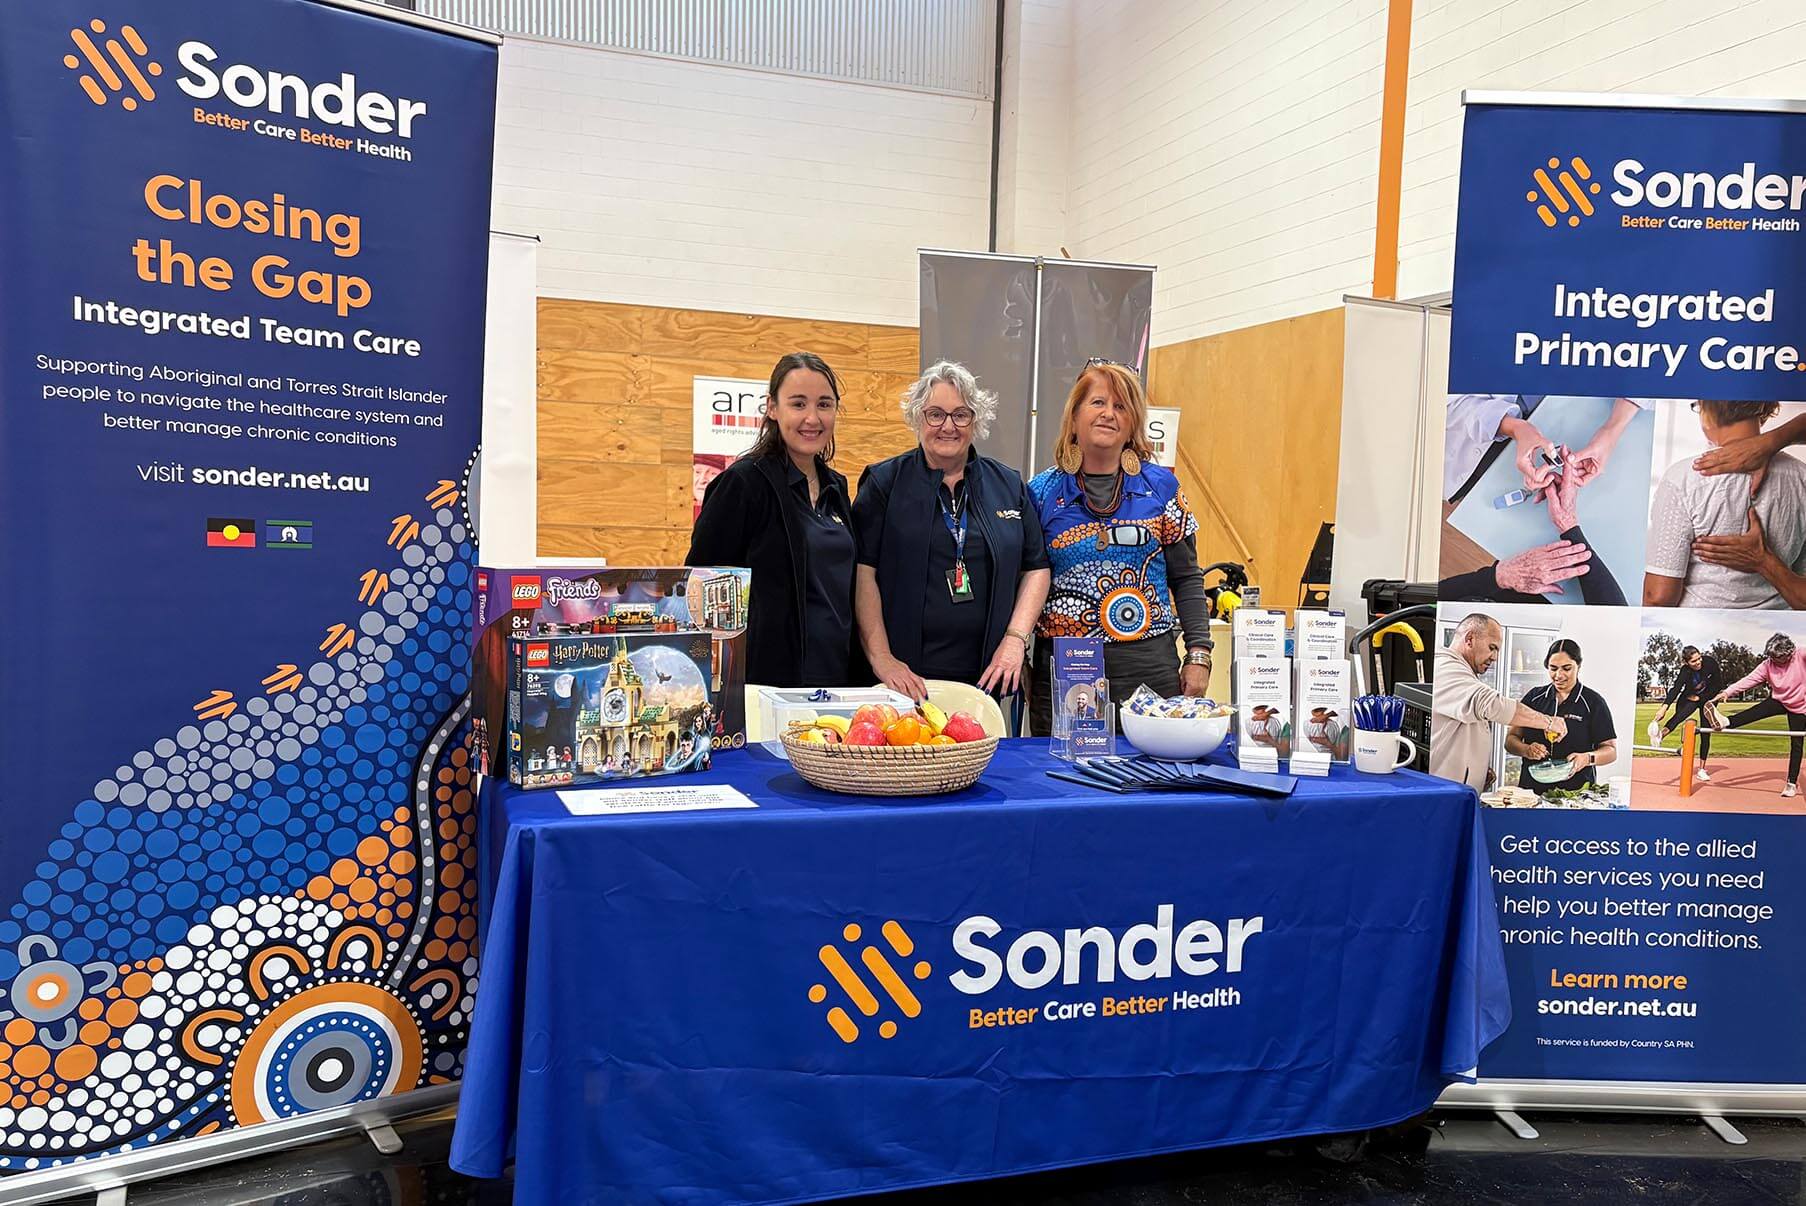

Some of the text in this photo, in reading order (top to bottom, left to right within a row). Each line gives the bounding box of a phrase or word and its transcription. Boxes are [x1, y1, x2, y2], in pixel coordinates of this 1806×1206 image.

[176, 40, 427, 139] Sonder
[194, 107, 412, 162] Better Care Better Health
[1610, 158, 1806, 210] Sonder
[144, 174, 361, 258] Closing
[1621, 215, 1800, 231] Better Care Better Health
[132, 239, 373, 317] the Gap
[1554, 284, 1774, 328] Integrated
[73, 296, 421, 358] Integrated Team Care
[1514, 332, 1806, 377] Primary Care.
[36, 354, 448, 405] Supporting Aboriginal and Torres Strait Islander
[43, 382, 444, 428] people to navigate the healthcare system and
[104, 413, 397, 448] better manage chronic conditions
[137, 460, 370, 493] visit sonder.net.au
[513, 577, 601, 607] LEGO Friends
[512, 616, 530, 629] 8+
[528, 651, 546, 660] LEGO
[553, 641, 609, 662] Harry Potter
[527, 673, 540, 683] 8+
[1500, 834, 1757, 859] Get access to the allied
[1490, 865, 1764, 890] health services you need
[1504, 895, 1774, 923] help you better manage
[949, 903, 1264, 995] Sonder
[1500, 926, 1762, 949] ronic health conditions.
[1551, 968, 1688, 990] Learn more
[968, 987, 1241, 1029] Better Care Better Health
[1537, 997, 1697, 1017] sonder.net.au
[1536, 1037, 1551, 1046] This
[1591, 1039, 1618, 1047] funded
[1619, 1039, 1630, 1049] by
[1631, 1040, 1662, 1049] Country
[1664, 1040, 1675, 1048] SA
